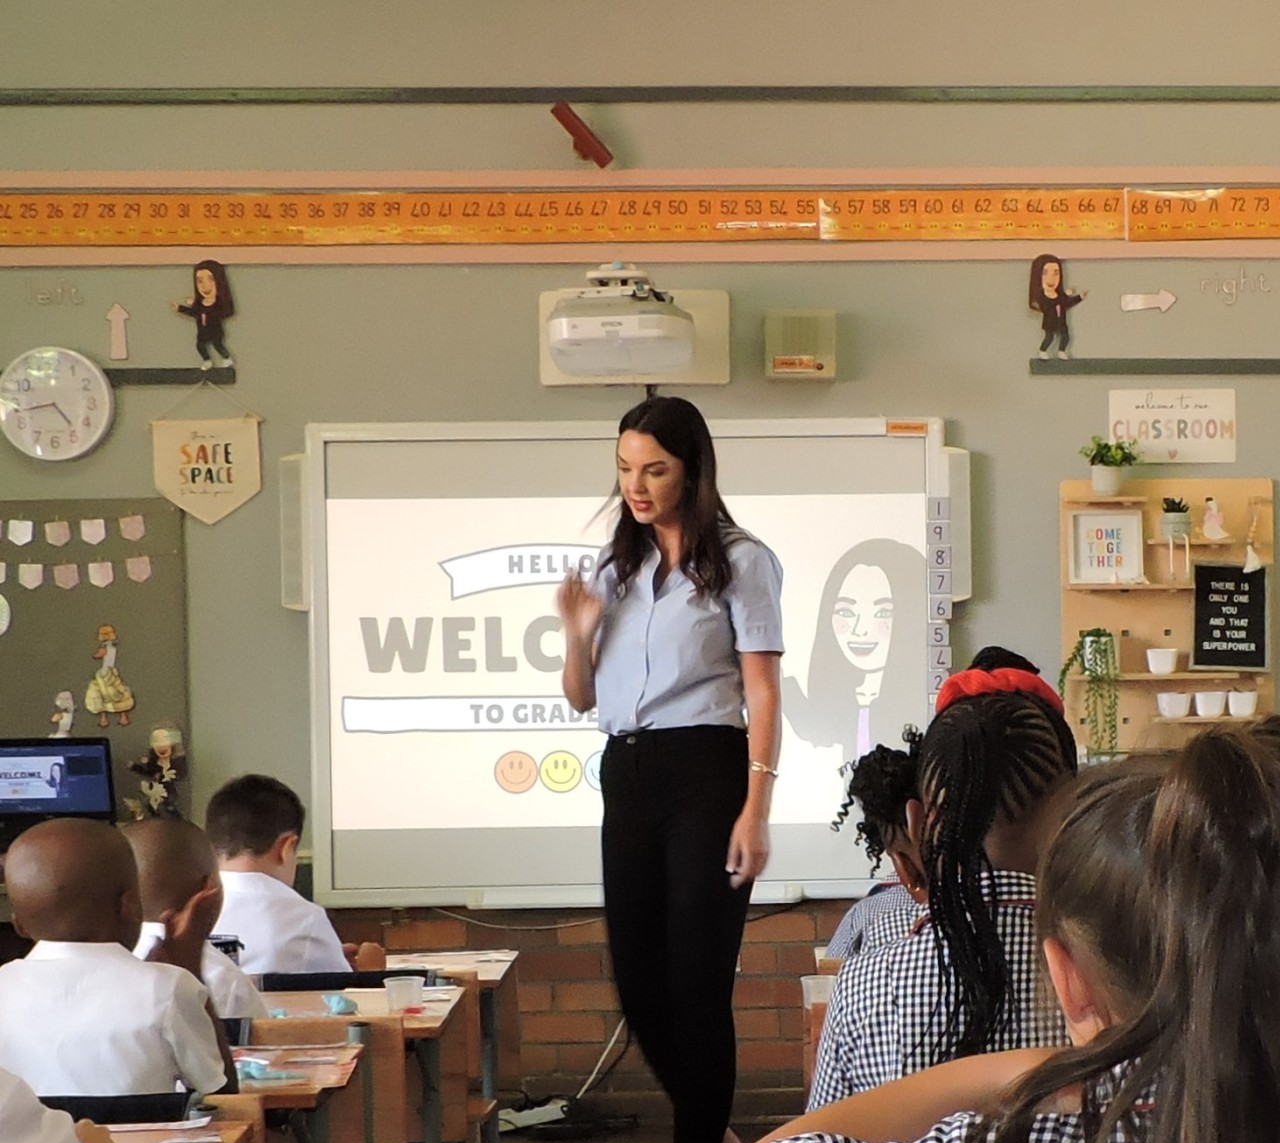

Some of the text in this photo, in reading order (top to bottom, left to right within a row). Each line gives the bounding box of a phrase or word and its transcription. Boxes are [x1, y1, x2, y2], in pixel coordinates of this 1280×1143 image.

[20, 203, 38, 218] 25
[47, 203, 63, 218] 26
[73, 203, 88, 218] 27
[98, 204, 116, 218] 28
[124, 203, 140, 218] 29
[150, 203, 168, 218] 30
[178, 203, 189, 218] 31
[204, 203, 220, 218] 32
[228, 203, 244, 218] 33
[254, 203, 271, 219] 34
[280, 203, 297, 218] 35
[308, 203, 325, 218] 36
[333, 203, 349, 217] 37
[358, 202, 375, 217] 38
[383, 202, 400, 216] 39
[411, 202, 430, 218] 40
[439, 202, 451, 217] 41
[462, 202, 479, 217] 42
[487, 202, 505, 217] 43
[515, 203, 533, 217] 44
[539, 201, 558, 217] 45
[565, 201, 583, 216] 46
[591, 201, 607, 216] 47
[618, 200, 636, 215] 48
[643, 200, 661, 216] 49
[669, 200, 687, 215] 50
[699, 200, 711, 214] 51
[721, 200, 738, 215] 52
[745, 200, 762, 215] 53
[770, 200, 787, 215] 54
[796, 199, 816, 215] 55
[848, 199, 864, 214] 57
[873, 199, 890, 214] 58
[900, 199, 916, 213] 59
[925, 199, 943, 213] 60
[952, 199, 964, 213] 61
[975, 199, 991, 213] 62
[1002, 198, 1018, 212] 63
[1027, 199, 1044, 213] 64
[1051, 199, 1068, 213] 65
[1078, 198, 1095, 213] 66
[1104, 197, 1120, 212] 67
[1131, 199, 1148, 215] 68
[1155, 198, 1172, 214] 69
[1179, 198, 1197, 213] 70
[1208, 197, 1219, 213] 71
[1231, 198, 1245, 211] 72
[1254, 197, 1269, 211] 73
[1200, 266, 1271, 305] right
[82, 378, 92, 391] 2
[1176, 393, 1192, 410] to
[82, 415, 92, 427] 4
[1112, 419, 1234, 440] CLASSROOM
[50, 435, 60, 449] 6
[180, 442, 233, 465] SAFE
[179, 466, 233, 484] SPACE
[933, 525, 943, 541] 9
[1087, 528, 1122, 540] COME
[508, 554, 595, 574] HELLO
[935, 549, 946, 566] 8
[1087, 555, 1123, 568] THER
[937, 574, 945, 590] 7
[1210, 581, 1249, 591] THERE IS
[1208, 593, 1249, 603] ONLY ONE
[936, 600, 946, 616] 6
[1221, 606, 1238, 614] YOU
[1209, 617, 1249, 627] AND THAT
[933, 627, 944, 643] 5
[1225, 630, 1247, 639] YOUR
[359, 615, 564, 673] WELC
[934, 674, 943, 691] 2
[470, 703, 599, 724] TO GRADE
[0, 771, 42, 779] ELCOME
